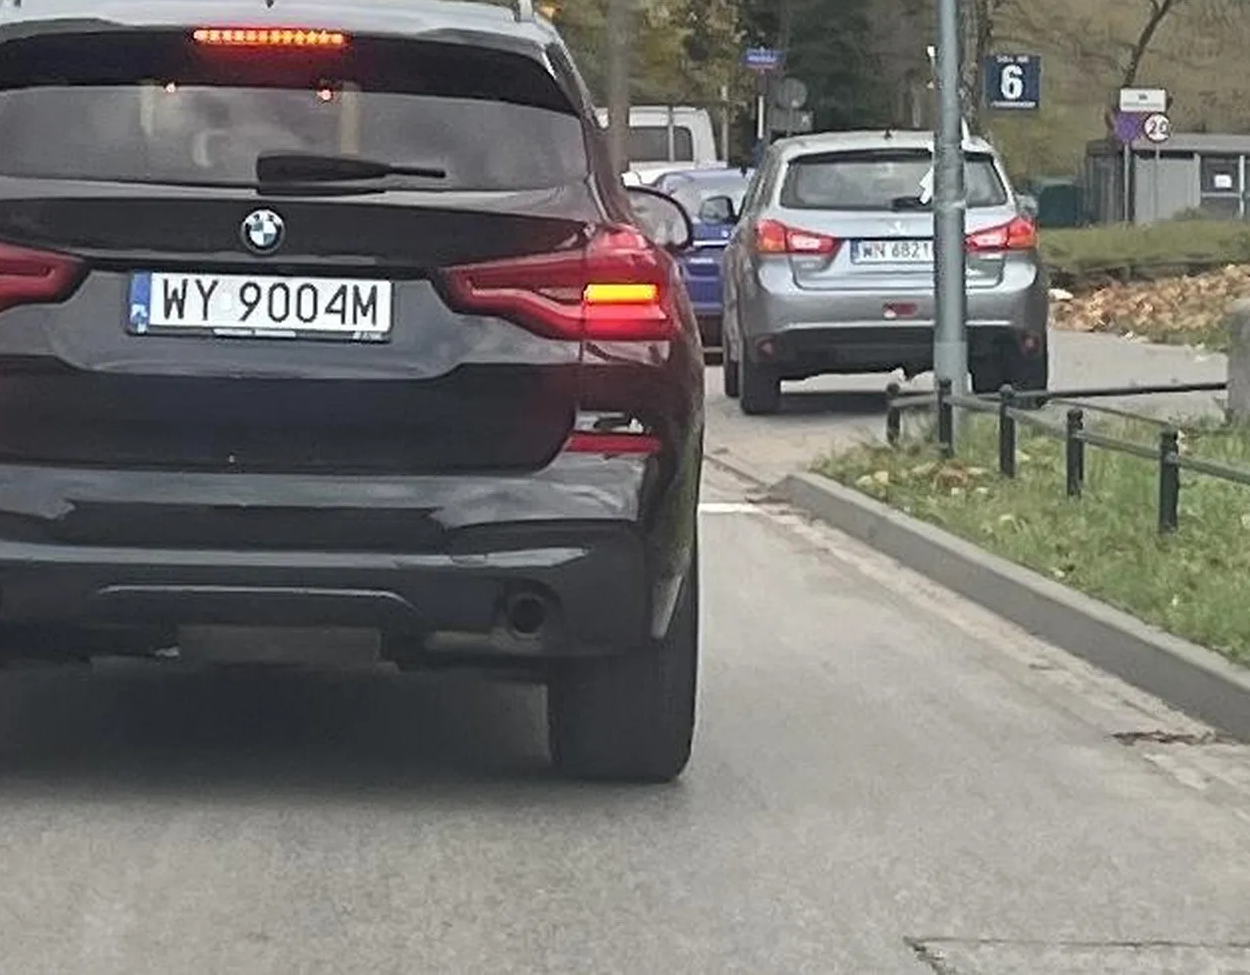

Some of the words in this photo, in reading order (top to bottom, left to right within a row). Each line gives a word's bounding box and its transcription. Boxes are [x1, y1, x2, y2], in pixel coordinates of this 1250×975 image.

[1001, 65, 1023, 99] 6
[163, 278, 219, 321] WY
[239, 282, 378, 326] 9004M
